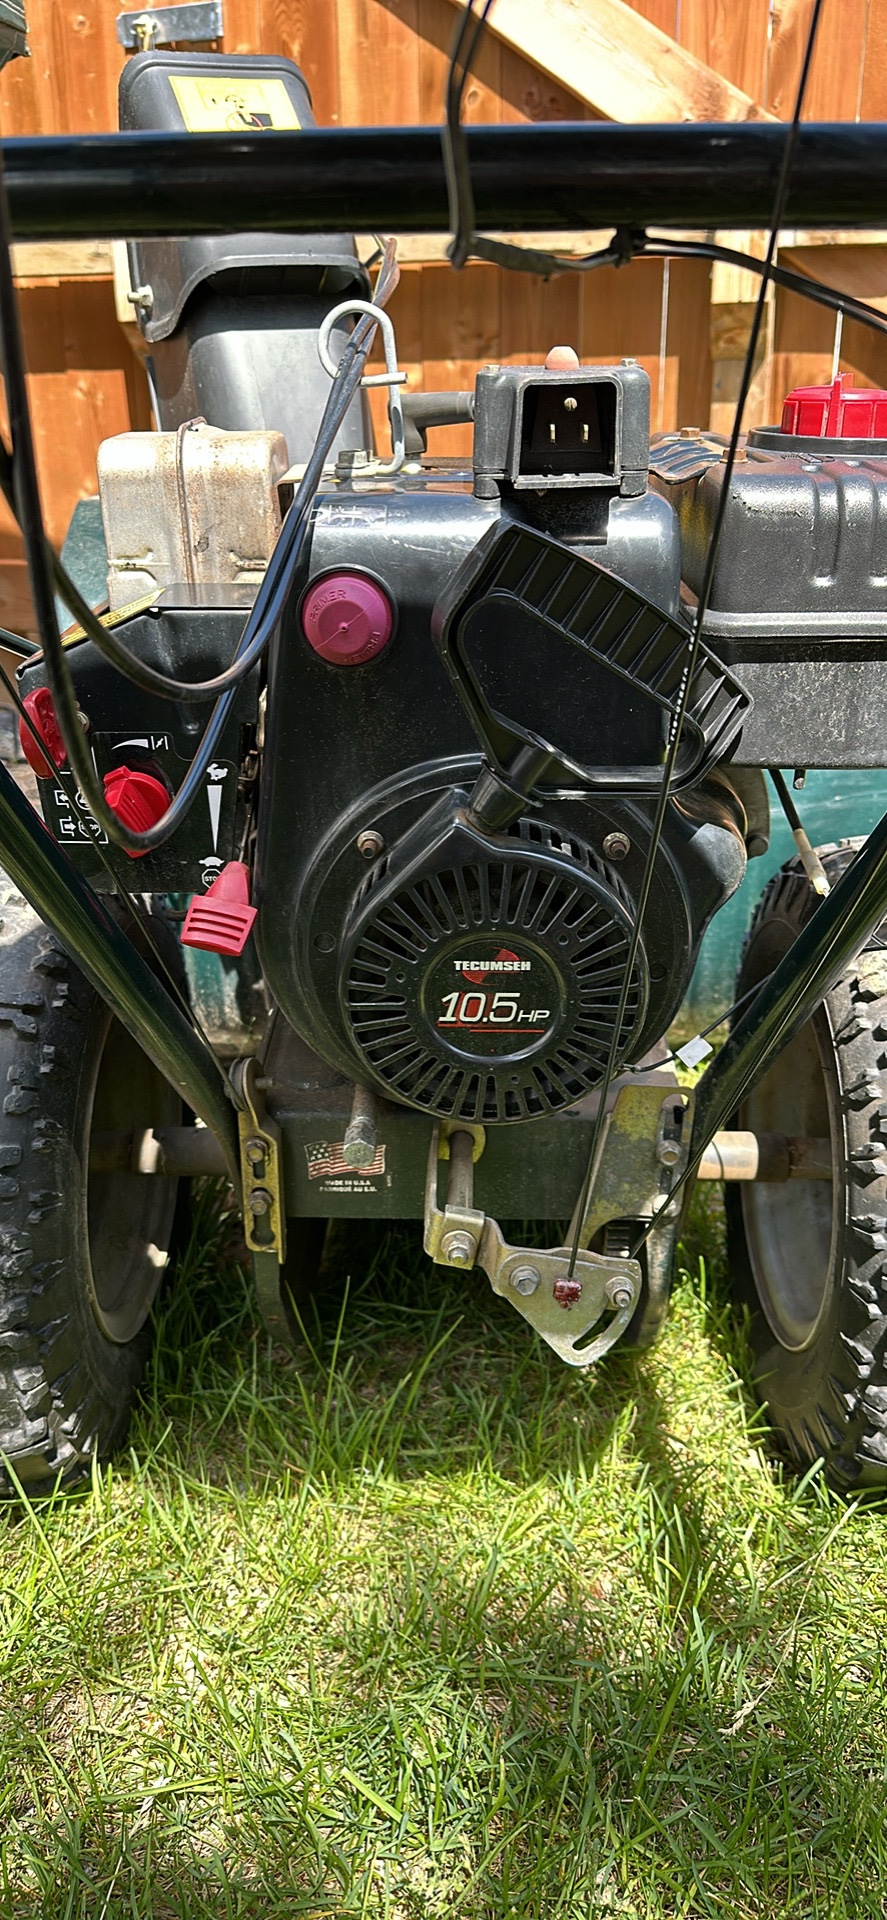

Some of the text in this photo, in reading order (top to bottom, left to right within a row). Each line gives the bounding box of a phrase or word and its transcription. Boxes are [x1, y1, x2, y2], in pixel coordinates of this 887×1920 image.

[310, 589, 346, 624] PRIMER
[453, 961, 531, 971] TECUMSEH
[438, 992, 551, 1023] 10.5 HP
